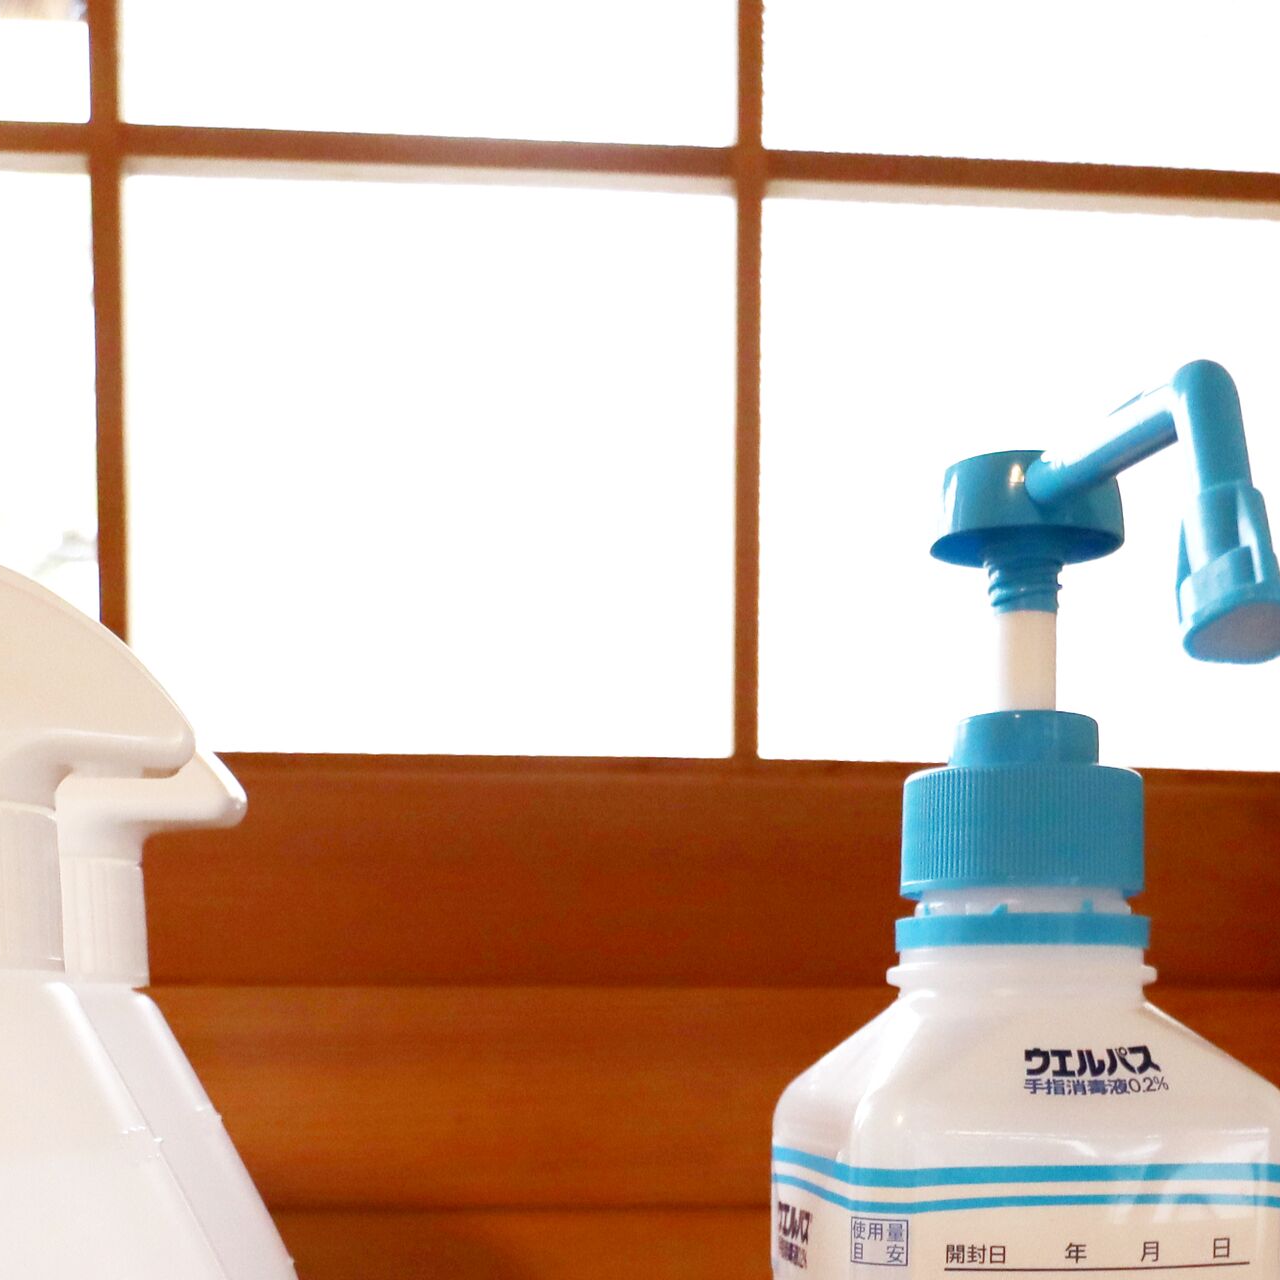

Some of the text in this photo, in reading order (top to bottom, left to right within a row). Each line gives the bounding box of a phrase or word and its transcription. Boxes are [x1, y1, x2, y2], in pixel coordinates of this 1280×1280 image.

[1024, 1044, 1162, 1078] ウエルパス
[1024, 1075, 1170, 1096] 手指消毒液0.2%
[853, 1221, 904, 1242] 使用量
[945, 1237, 1231, 1265] 開封日 年 月 日
